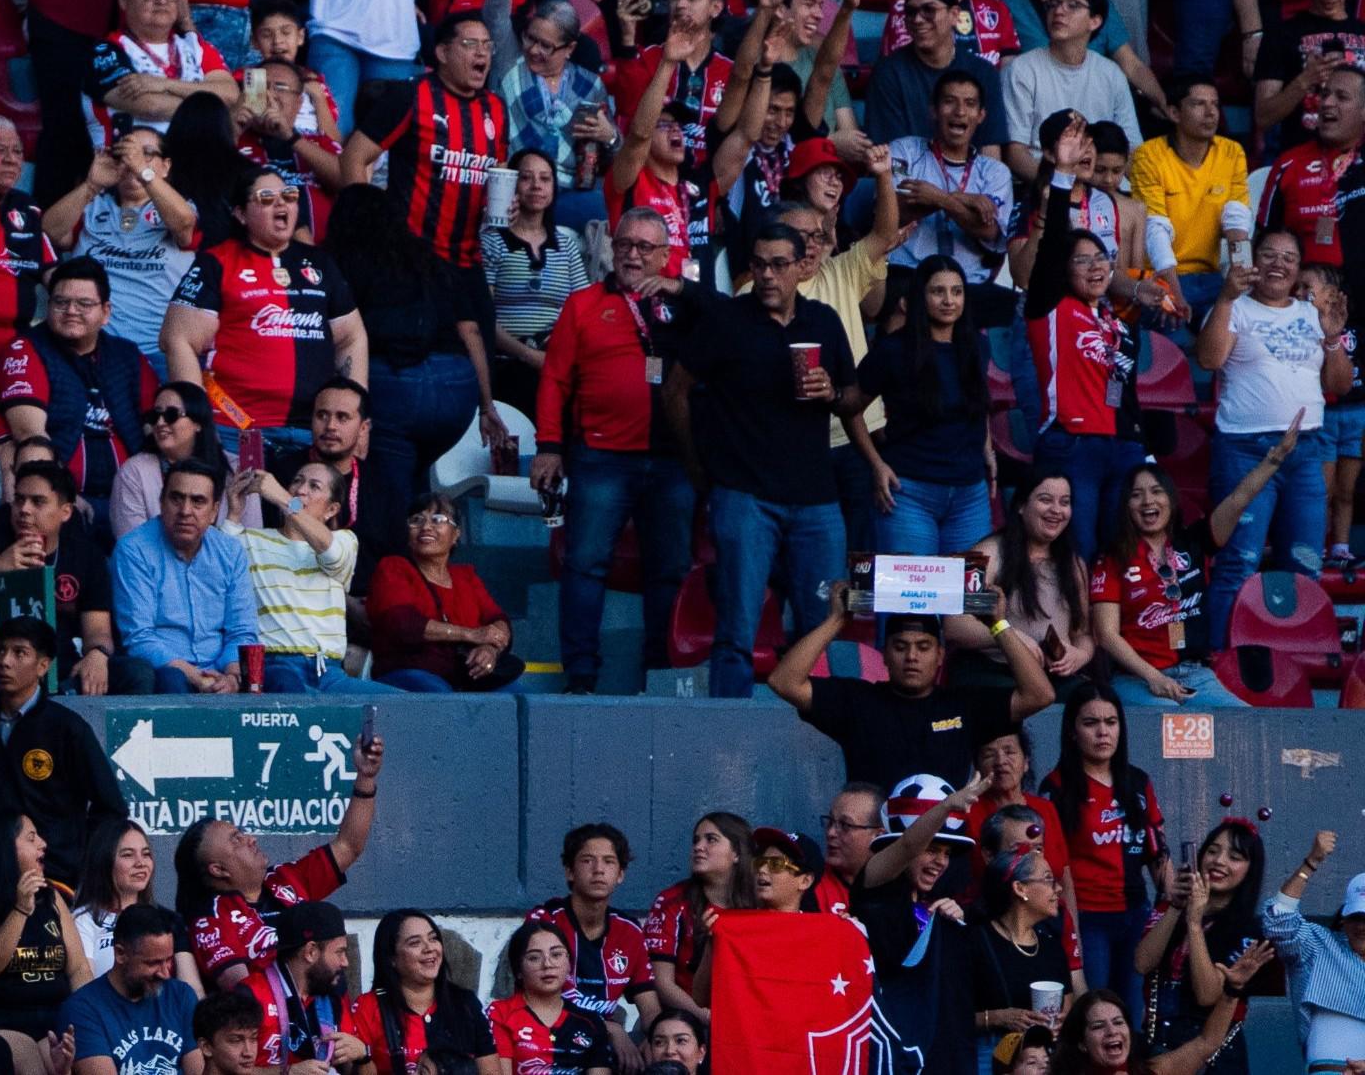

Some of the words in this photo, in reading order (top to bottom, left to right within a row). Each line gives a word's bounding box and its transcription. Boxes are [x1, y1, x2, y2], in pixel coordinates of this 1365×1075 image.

[251, 303, 323, 331] Caliente
[257, 326, 325, 340] caliente.mx
[893, 564, 946, 574] MICHELADAS
[241, 712, 300, 727] PUERTA
[1166, 717, 1211, 742] t-28
[258, 742, 281, 784] 7
[129, 798, 172, 826] UTA
[177, 800, 208, 825] DE
[143, 1026, 183, 1053] LAKE
